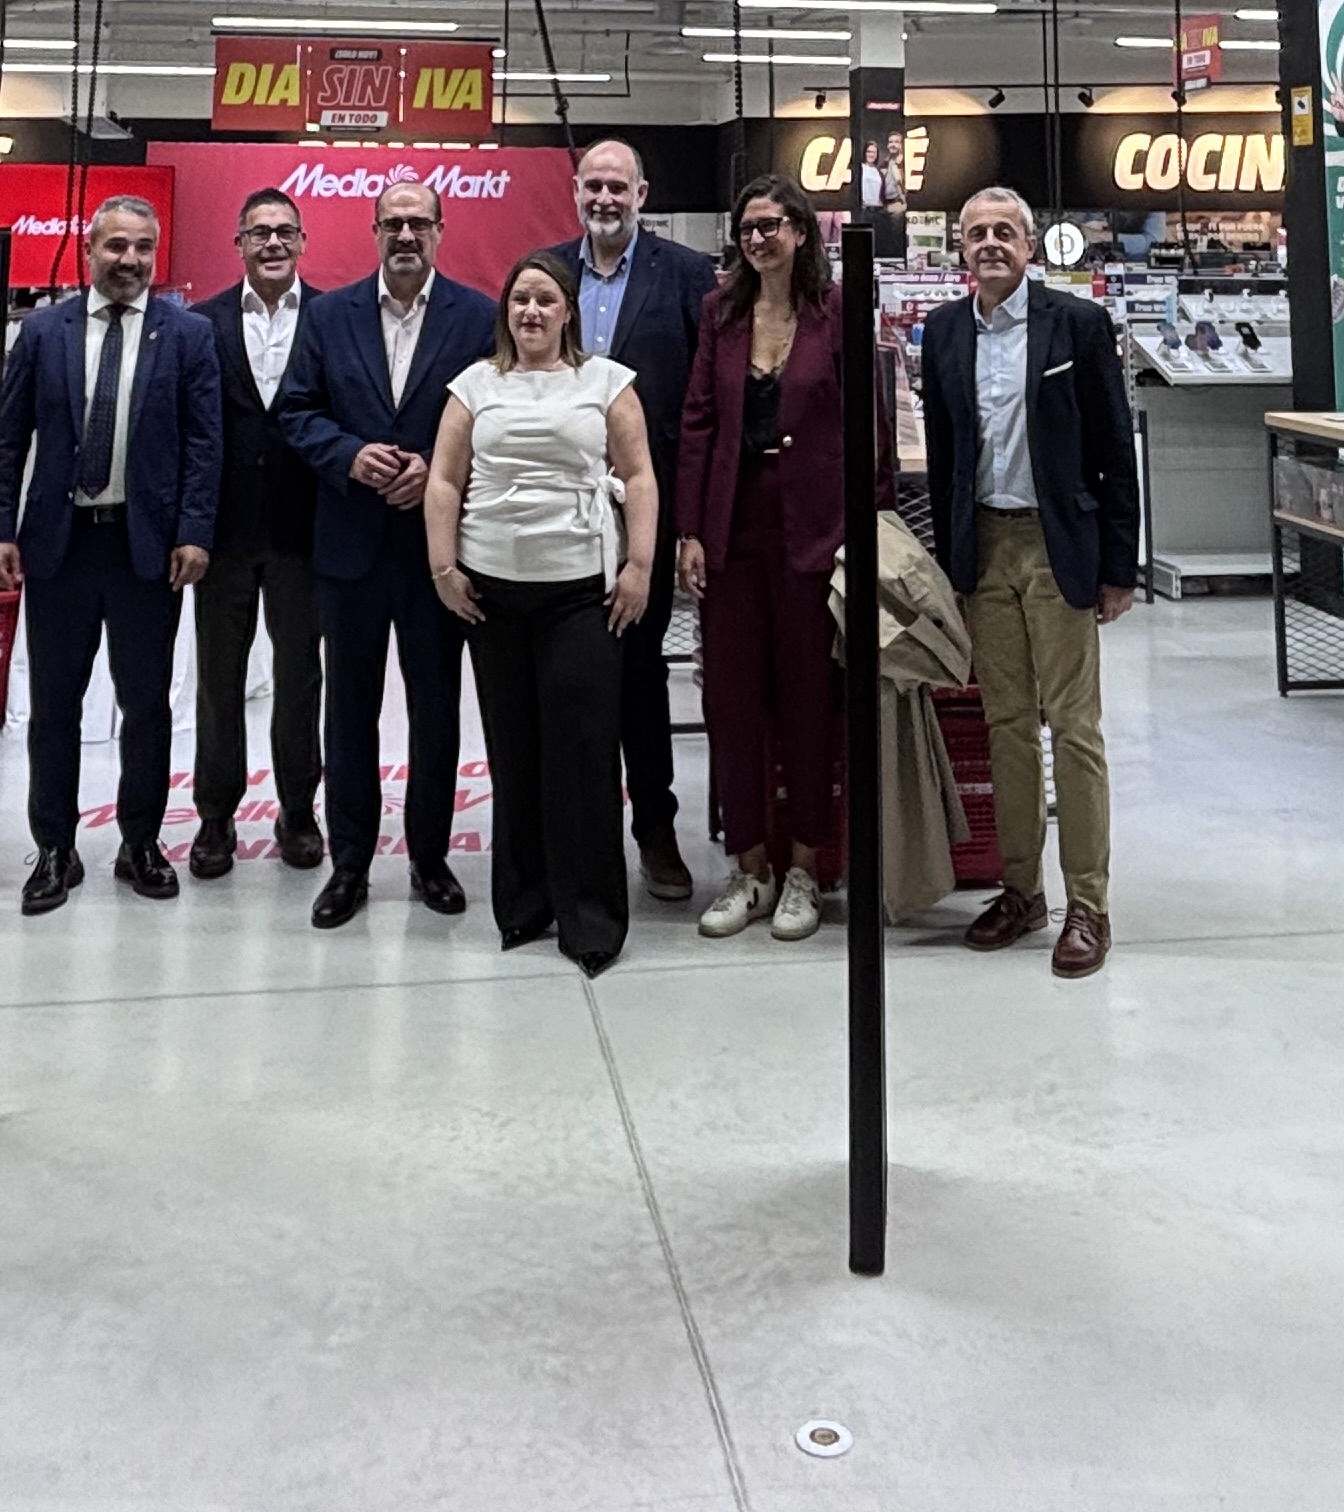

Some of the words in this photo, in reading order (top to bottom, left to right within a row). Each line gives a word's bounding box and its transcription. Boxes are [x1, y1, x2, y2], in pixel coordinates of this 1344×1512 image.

[317, 64, 392, 107] SIN
[412, 67, 483, 111] IVA
[331, 113, 346, 125] EN
[348, 113, 378, 125] TODO
[800, 126, 930, 192] CAÉ
[279, 163, 386, 199] Media
[423, 164, 512, 199] Markt
